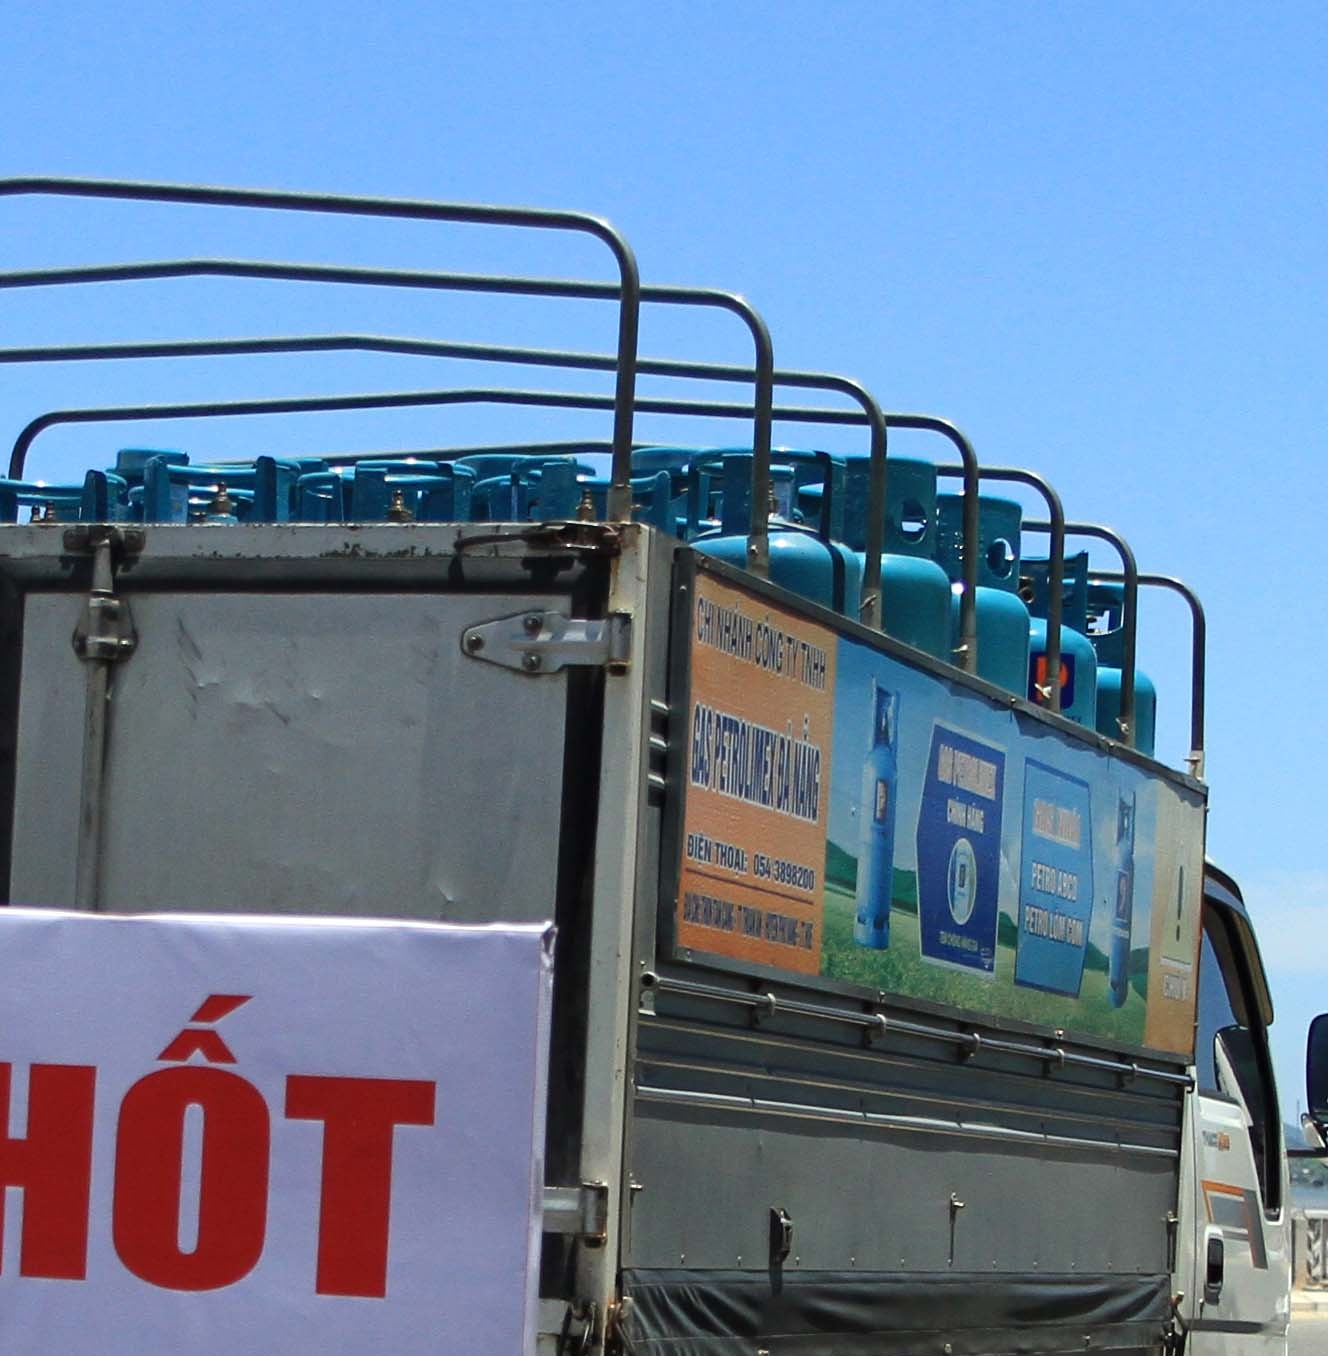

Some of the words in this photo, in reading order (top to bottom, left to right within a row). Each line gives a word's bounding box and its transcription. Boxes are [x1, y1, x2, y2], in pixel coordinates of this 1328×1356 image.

[697, 597, 714, 646] CHI
[755, 614, 785, 677] CÔNG
[785, 635, 800, 680] TY
[800, 642, 827, 691] TNHH
[691, 702, 712, 790] GAS
[712, 709, 775, 810] PETROLIMEX
